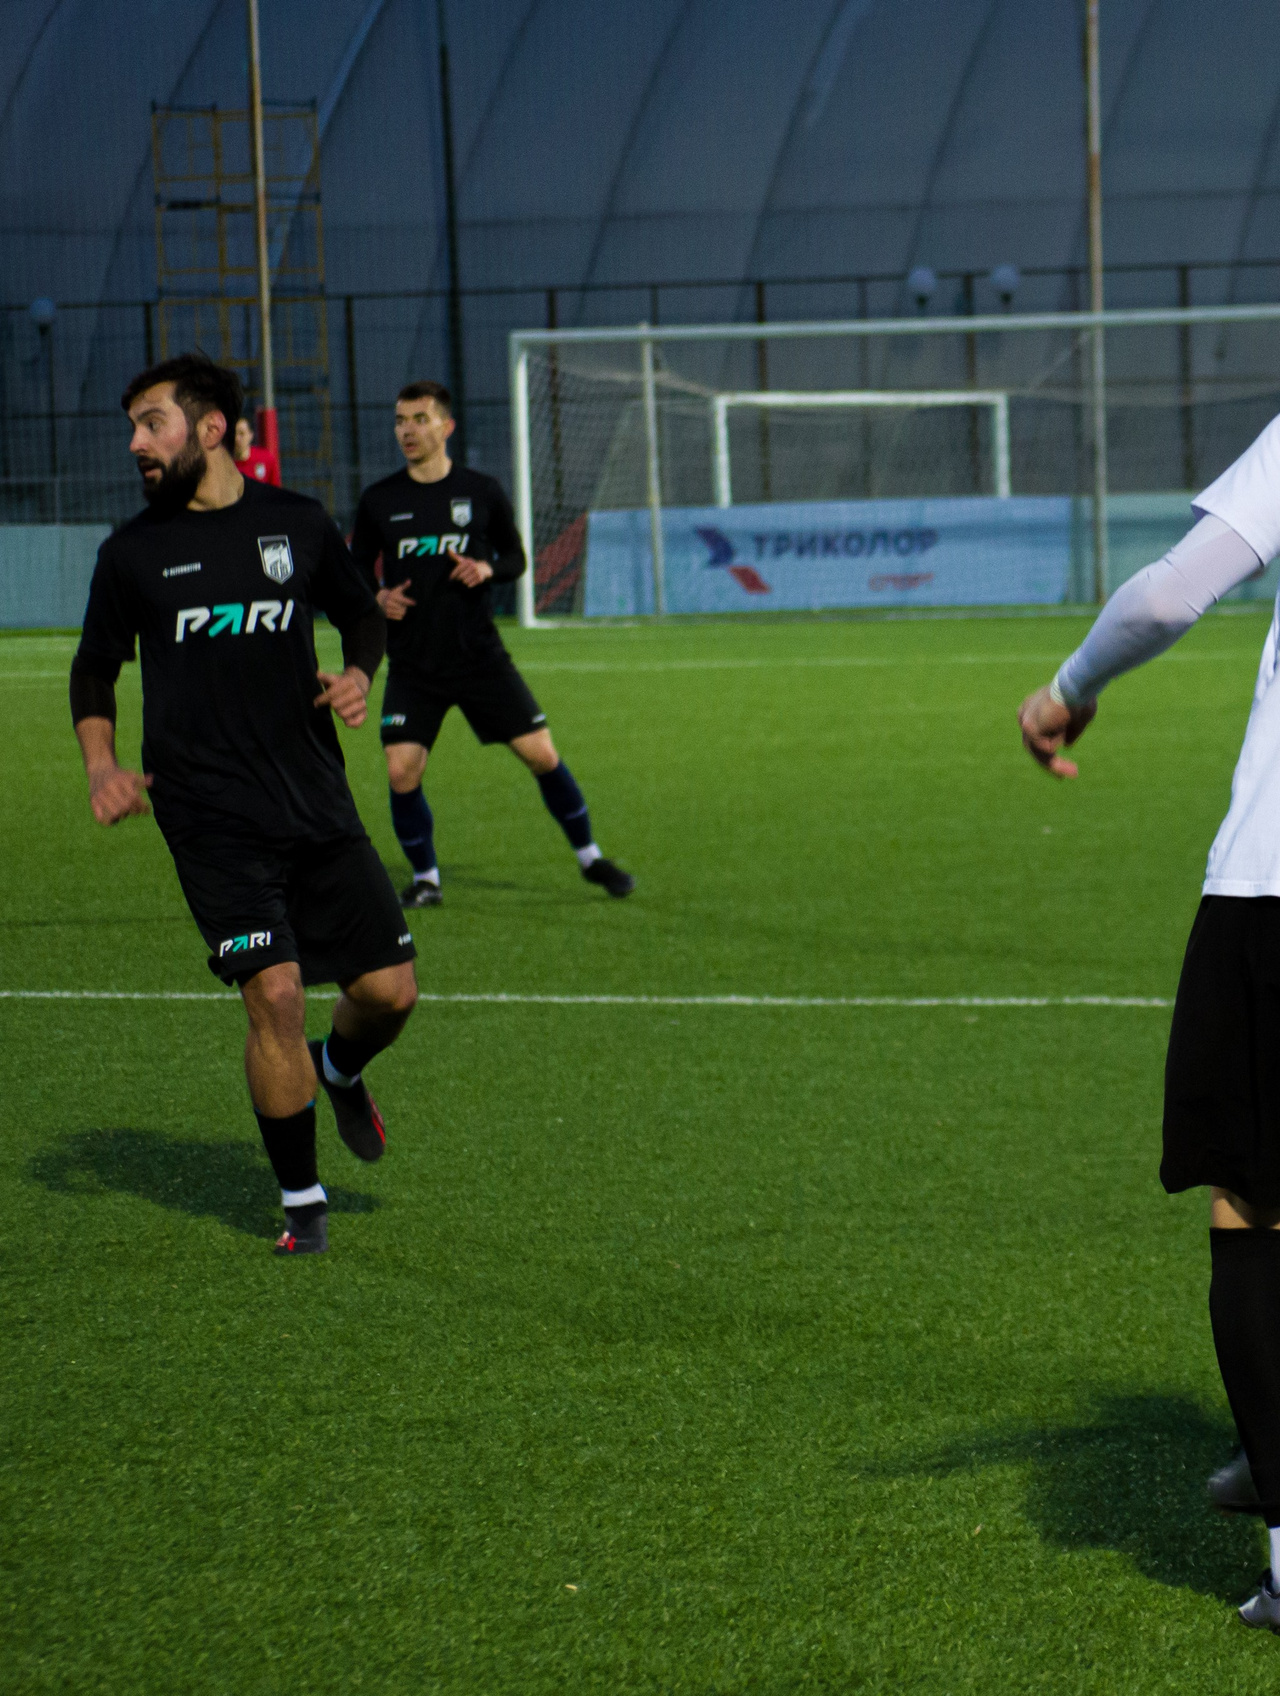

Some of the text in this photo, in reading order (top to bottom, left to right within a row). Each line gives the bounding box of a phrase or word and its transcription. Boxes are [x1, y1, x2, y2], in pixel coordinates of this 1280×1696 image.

[398, 533, 469, 559] PARI
[754, 528, 937, 559] ТРИКОЛОР
[175, 599, 294, 643] PARI
[219, 931, 271, 957] PARI
